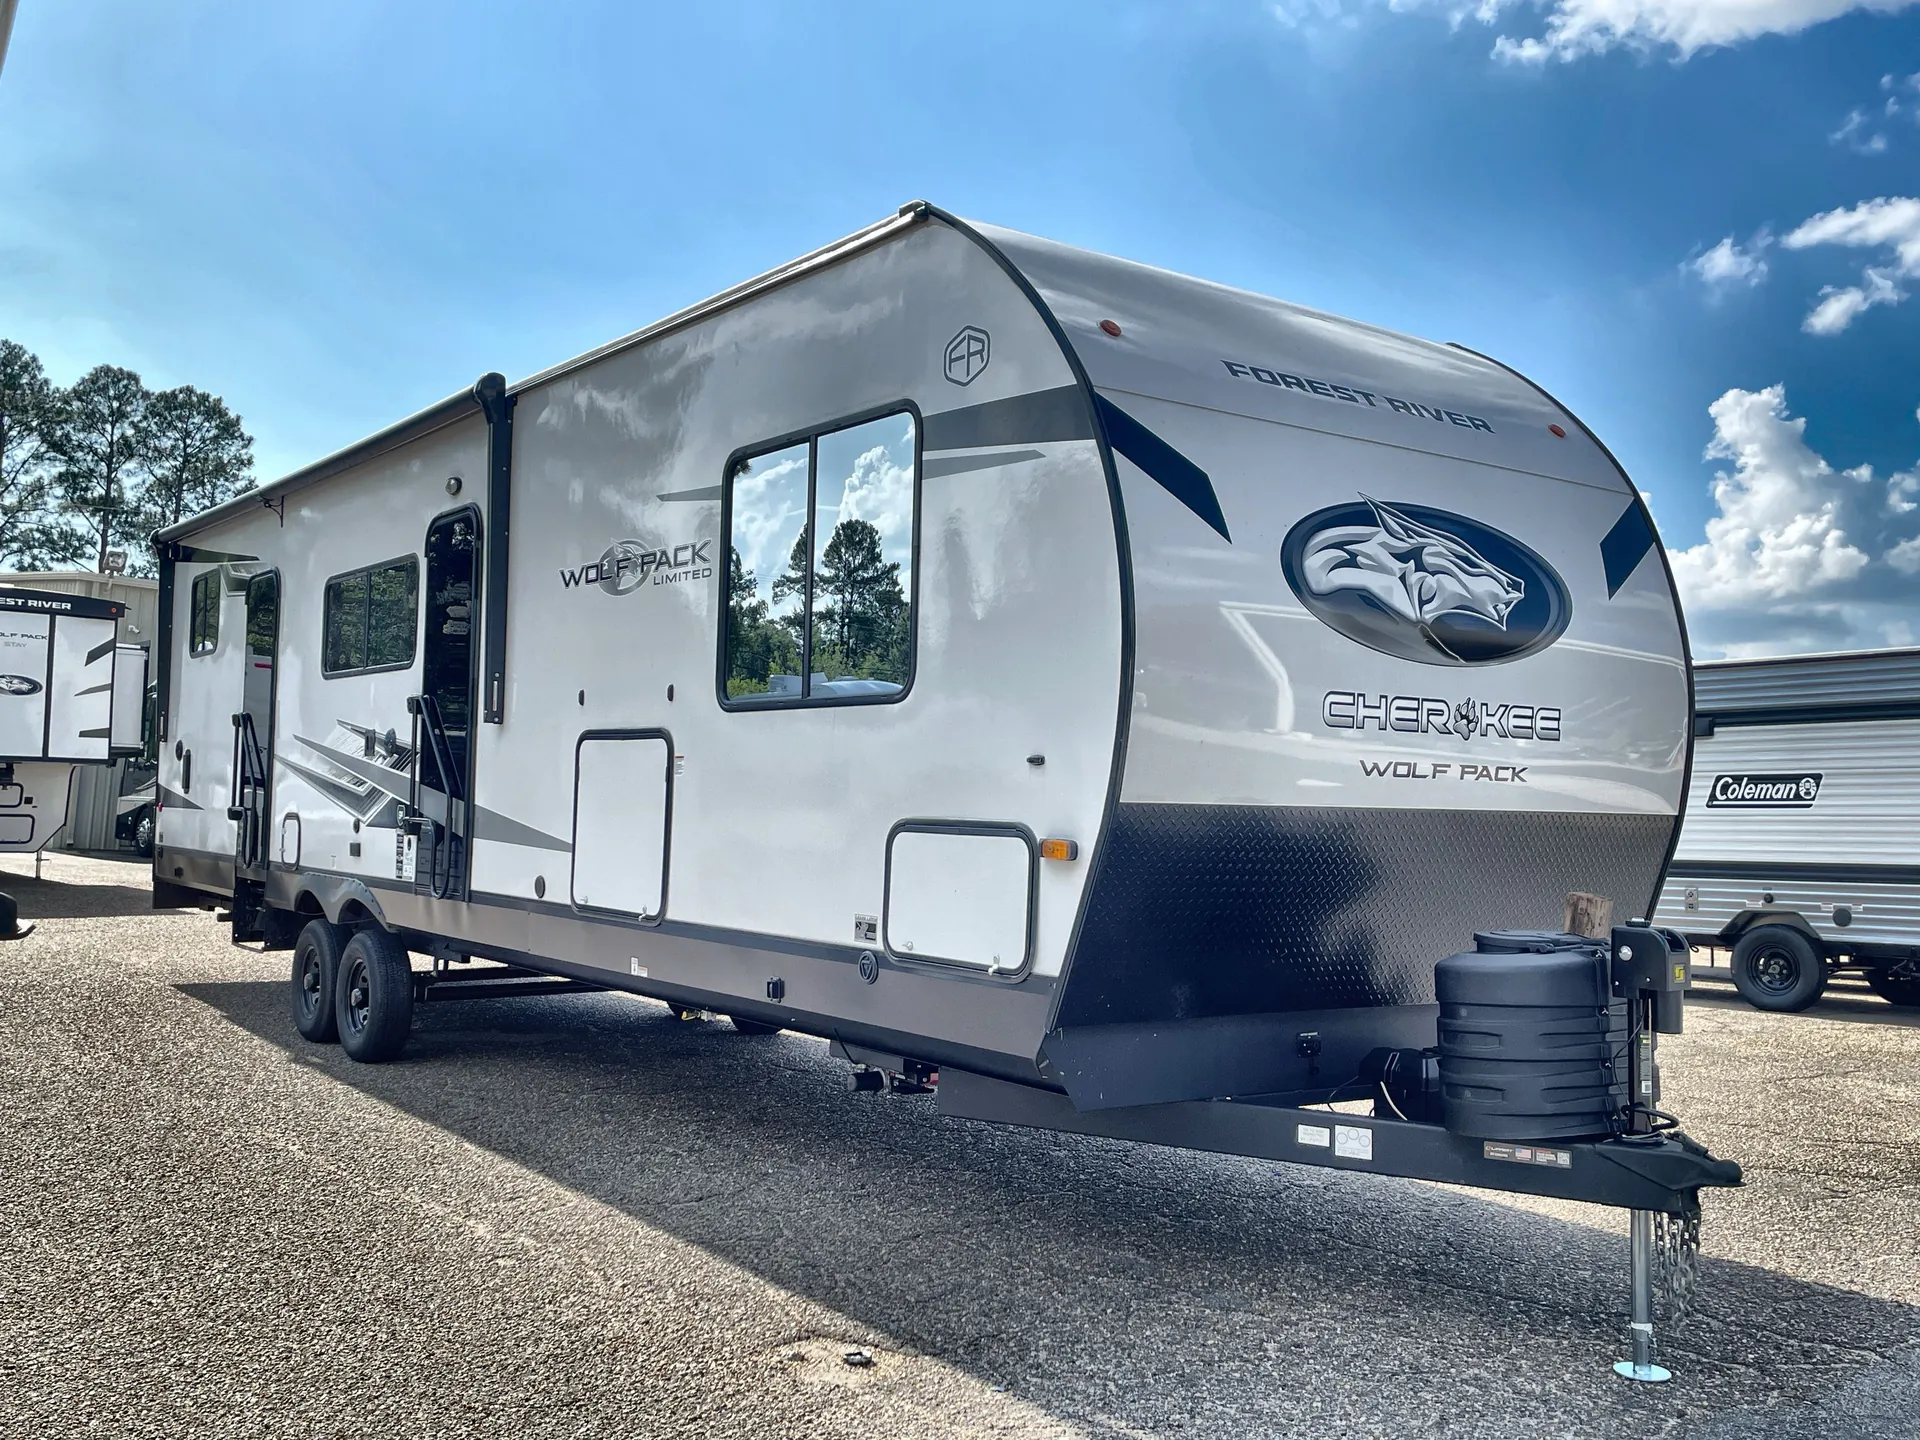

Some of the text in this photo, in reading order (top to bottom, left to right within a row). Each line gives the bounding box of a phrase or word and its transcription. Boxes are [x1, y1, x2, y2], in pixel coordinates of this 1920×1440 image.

[1220, 359, 1496, 434] FOREST RIVER
[559, 538, 713, 590] WOLF PACK
[653, 567, 712, 586] LIMITED
[28, 599, 71, 610] RIVER
[21, 633, 48, 641] PACK
[1359, 759, 1529, 783] WOLF PACK
[1715, 776, 1797, 801] Coleman
